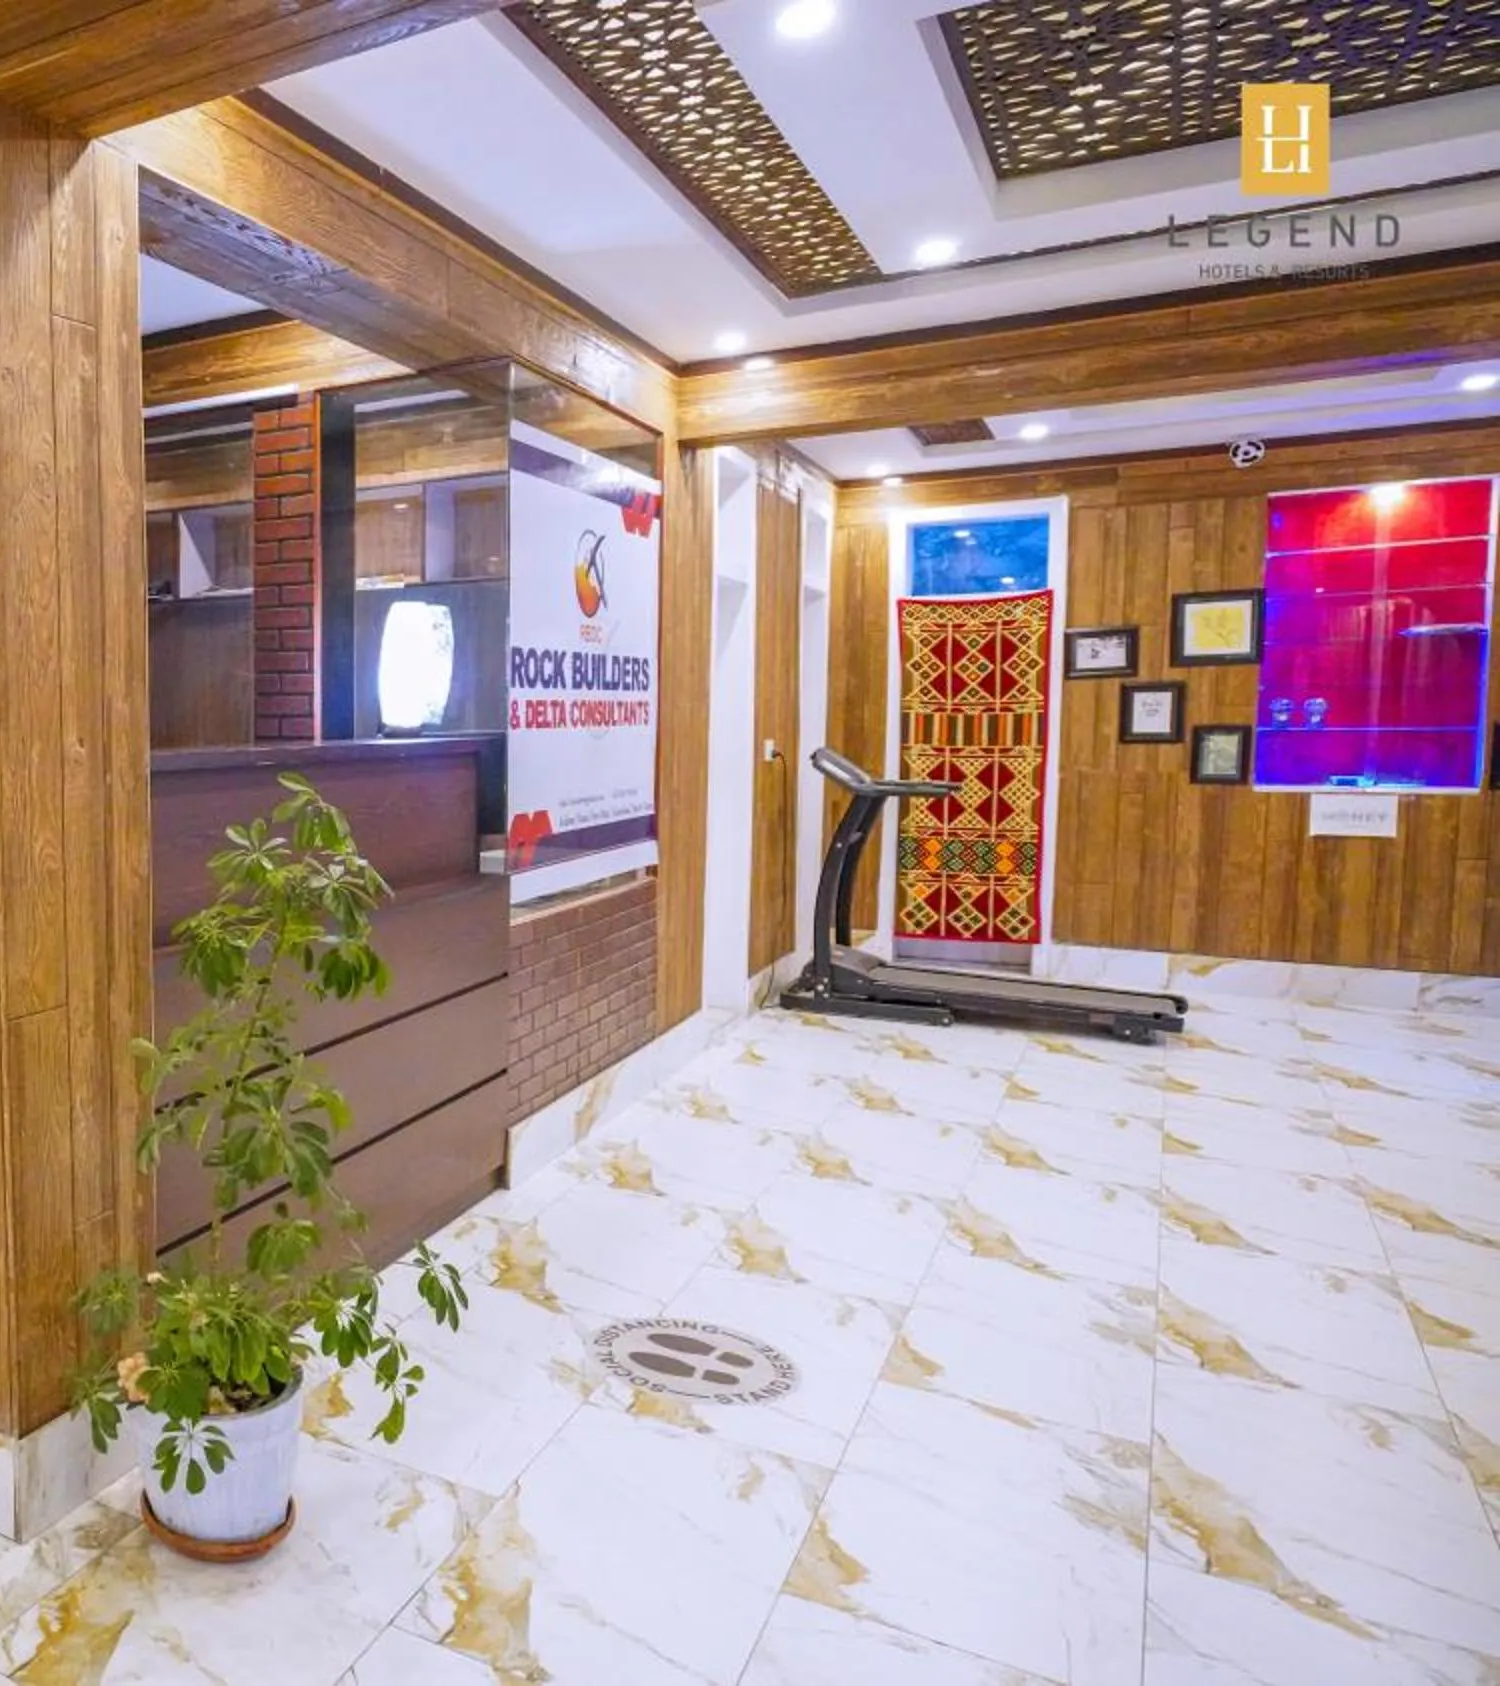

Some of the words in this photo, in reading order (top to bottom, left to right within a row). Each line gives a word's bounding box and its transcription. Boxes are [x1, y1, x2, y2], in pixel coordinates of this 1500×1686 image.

[511, 646, 567, 690] ROCK
[572, 651, 650, 692] BUILDERS
[510, 700, 520, 730] &
[525, 699, 567, 729] DELTA
[570, 700, 650, 729] CONSULTANTS
